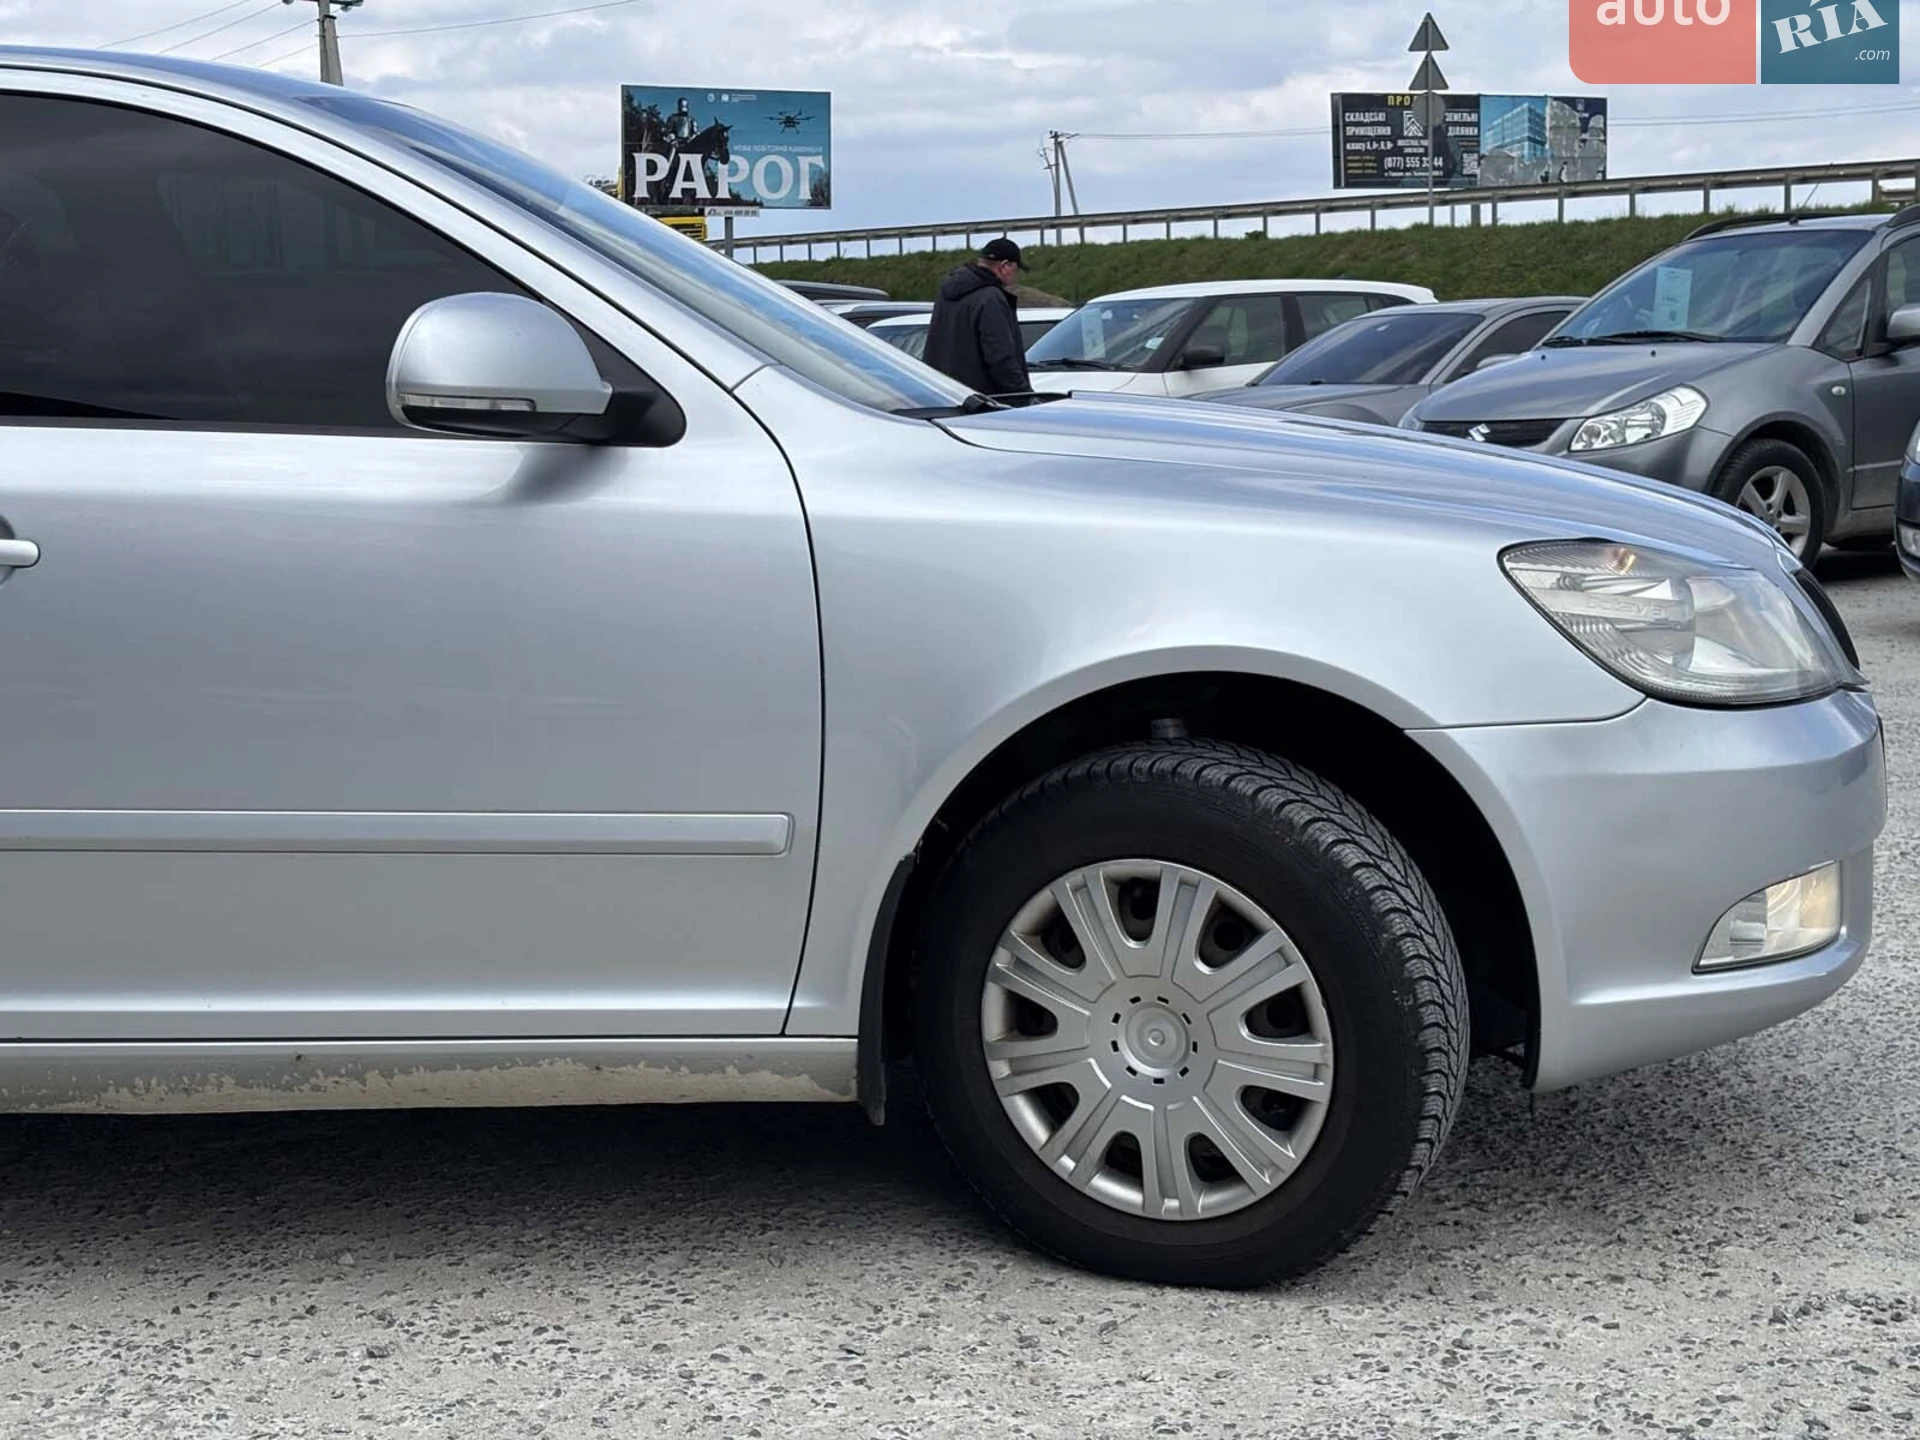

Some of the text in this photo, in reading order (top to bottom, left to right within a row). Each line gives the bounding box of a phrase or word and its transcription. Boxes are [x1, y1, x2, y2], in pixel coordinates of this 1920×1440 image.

[1387, 95, 1417, 106] ПРО
[1384, 156, 1404, 170] (077)
[1405, 156, 1420, 168] 555
[1433, 156, 1443, 168] 44
[632, 152, 825, 200] РАРОГ
